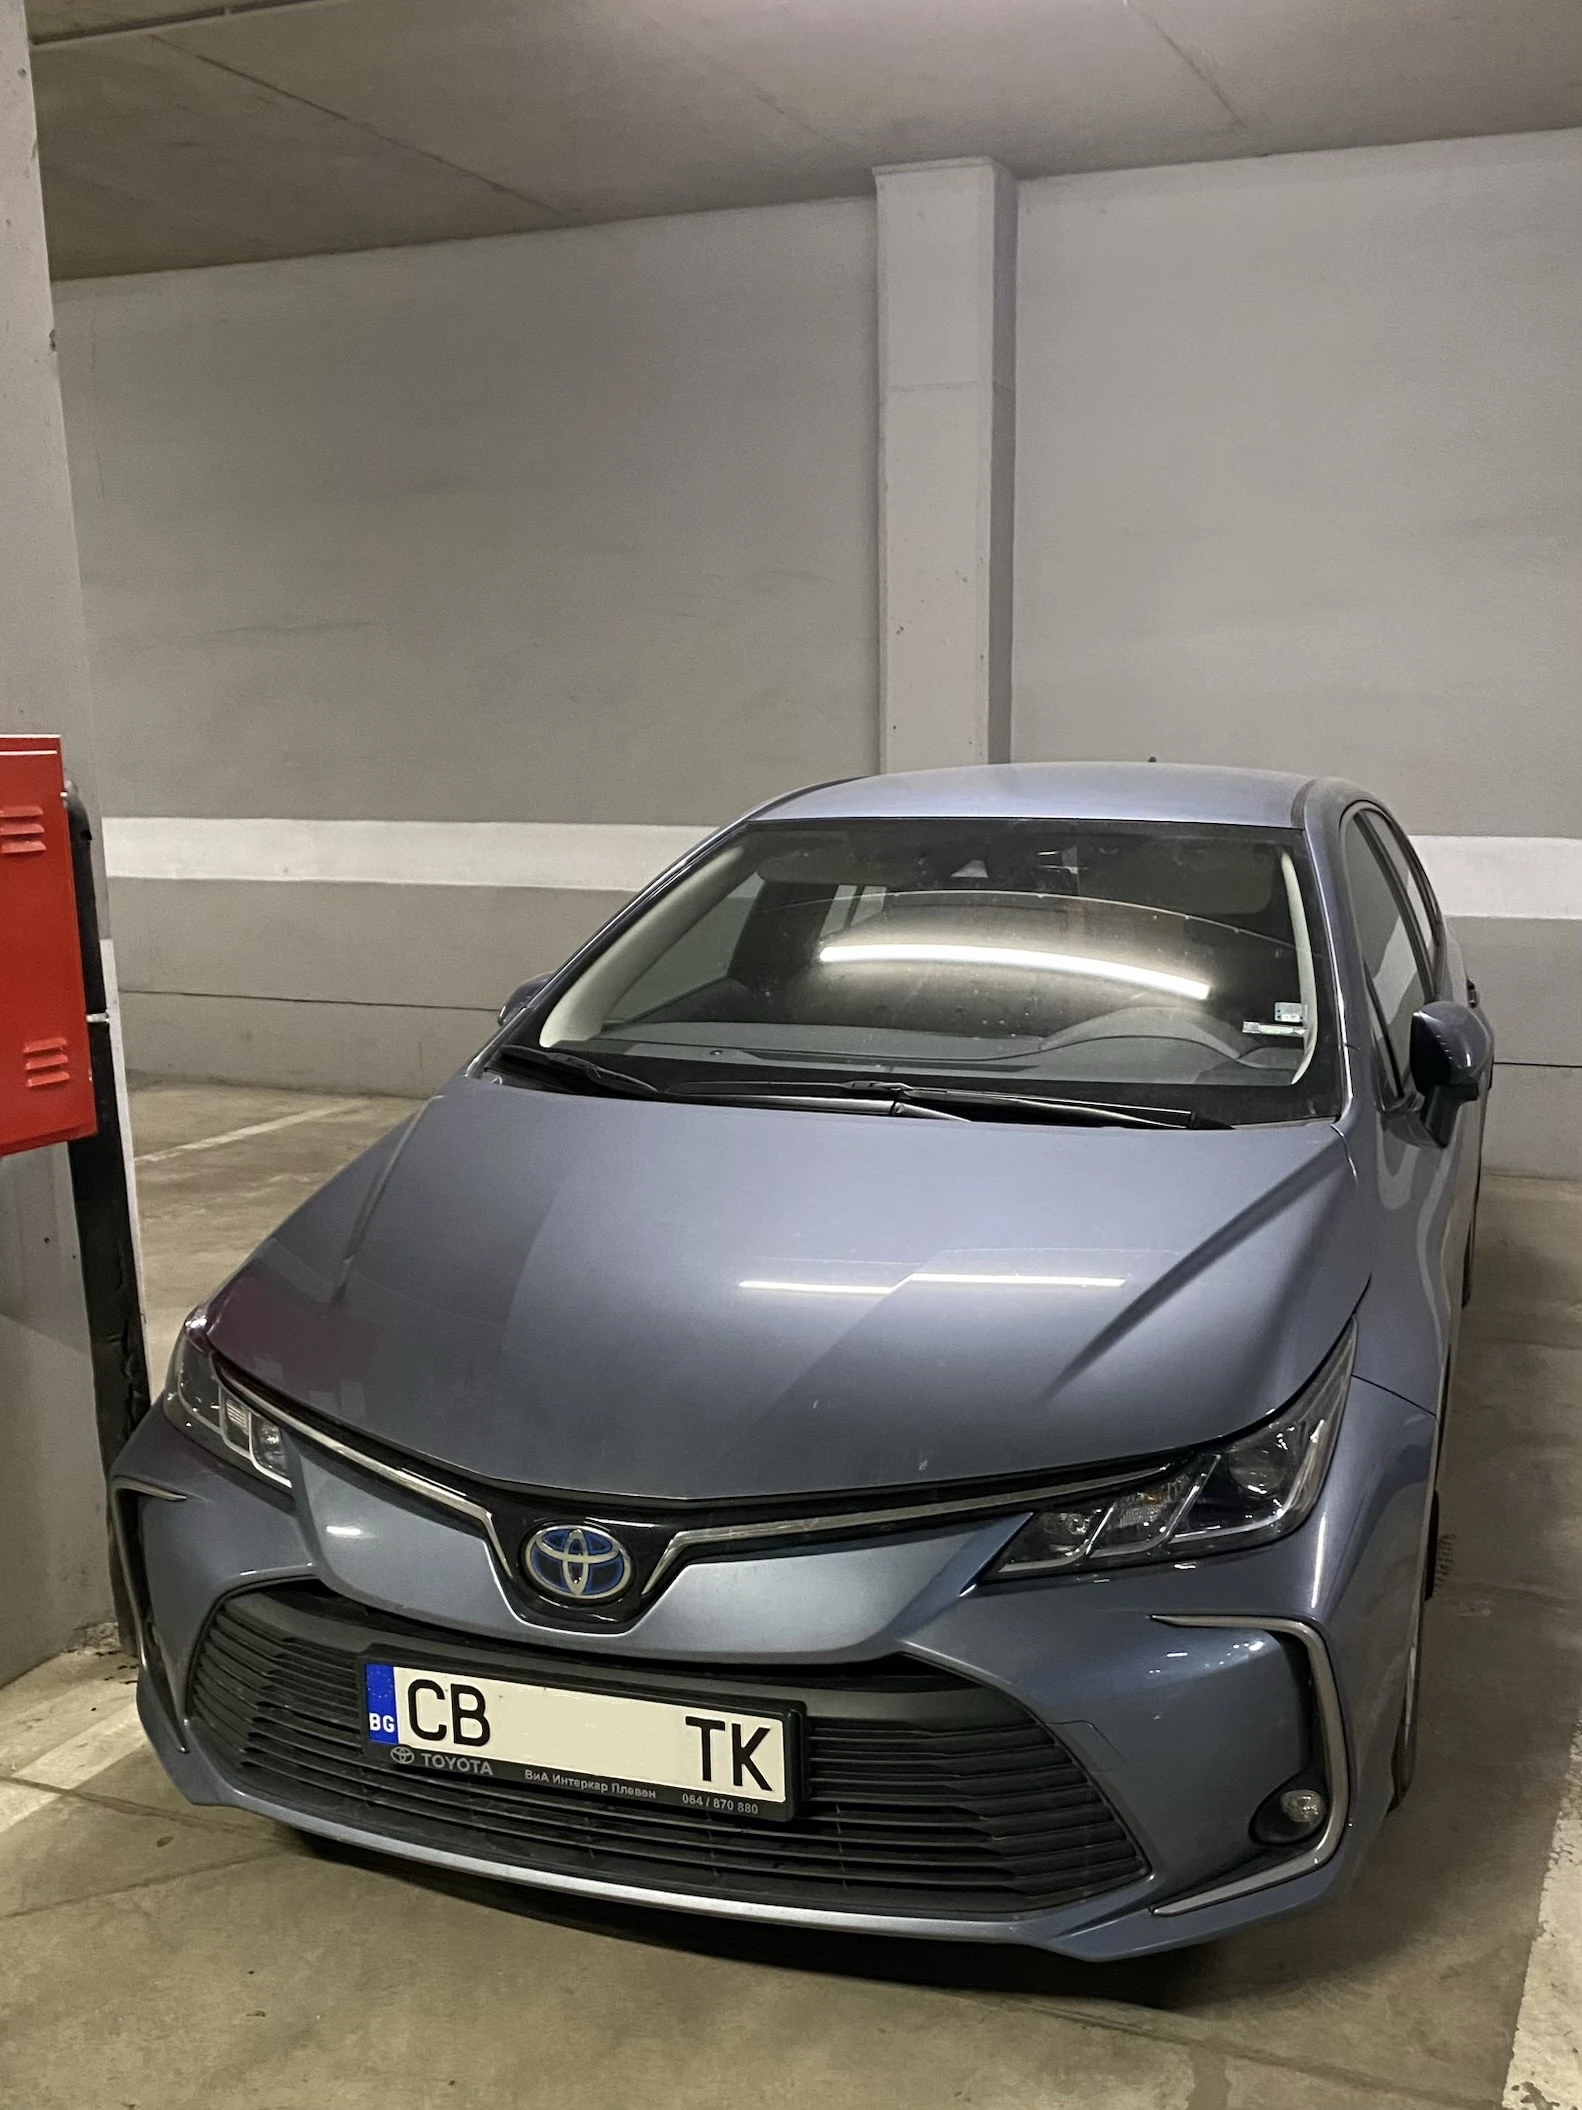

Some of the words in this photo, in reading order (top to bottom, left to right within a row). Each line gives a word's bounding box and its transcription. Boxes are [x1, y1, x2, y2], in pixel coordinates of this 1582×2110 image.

[369, 1713, 395, 1733] BG
[407, 1679, 491, 1747] CB
[685, 1716, 774, 1791] TK
[421, 1753, 493, 1776] TOYOTA
[525, 1769, 549, 1783] ВиА
[552, 1772, 608, 1794] Интеркар
[611, 1782, 656, 1800] Плевен
[682, 1794, 703, 1806] 064
[713, 1798, 734, 1811] 870
[737, 1802, 759, 1815] 880
